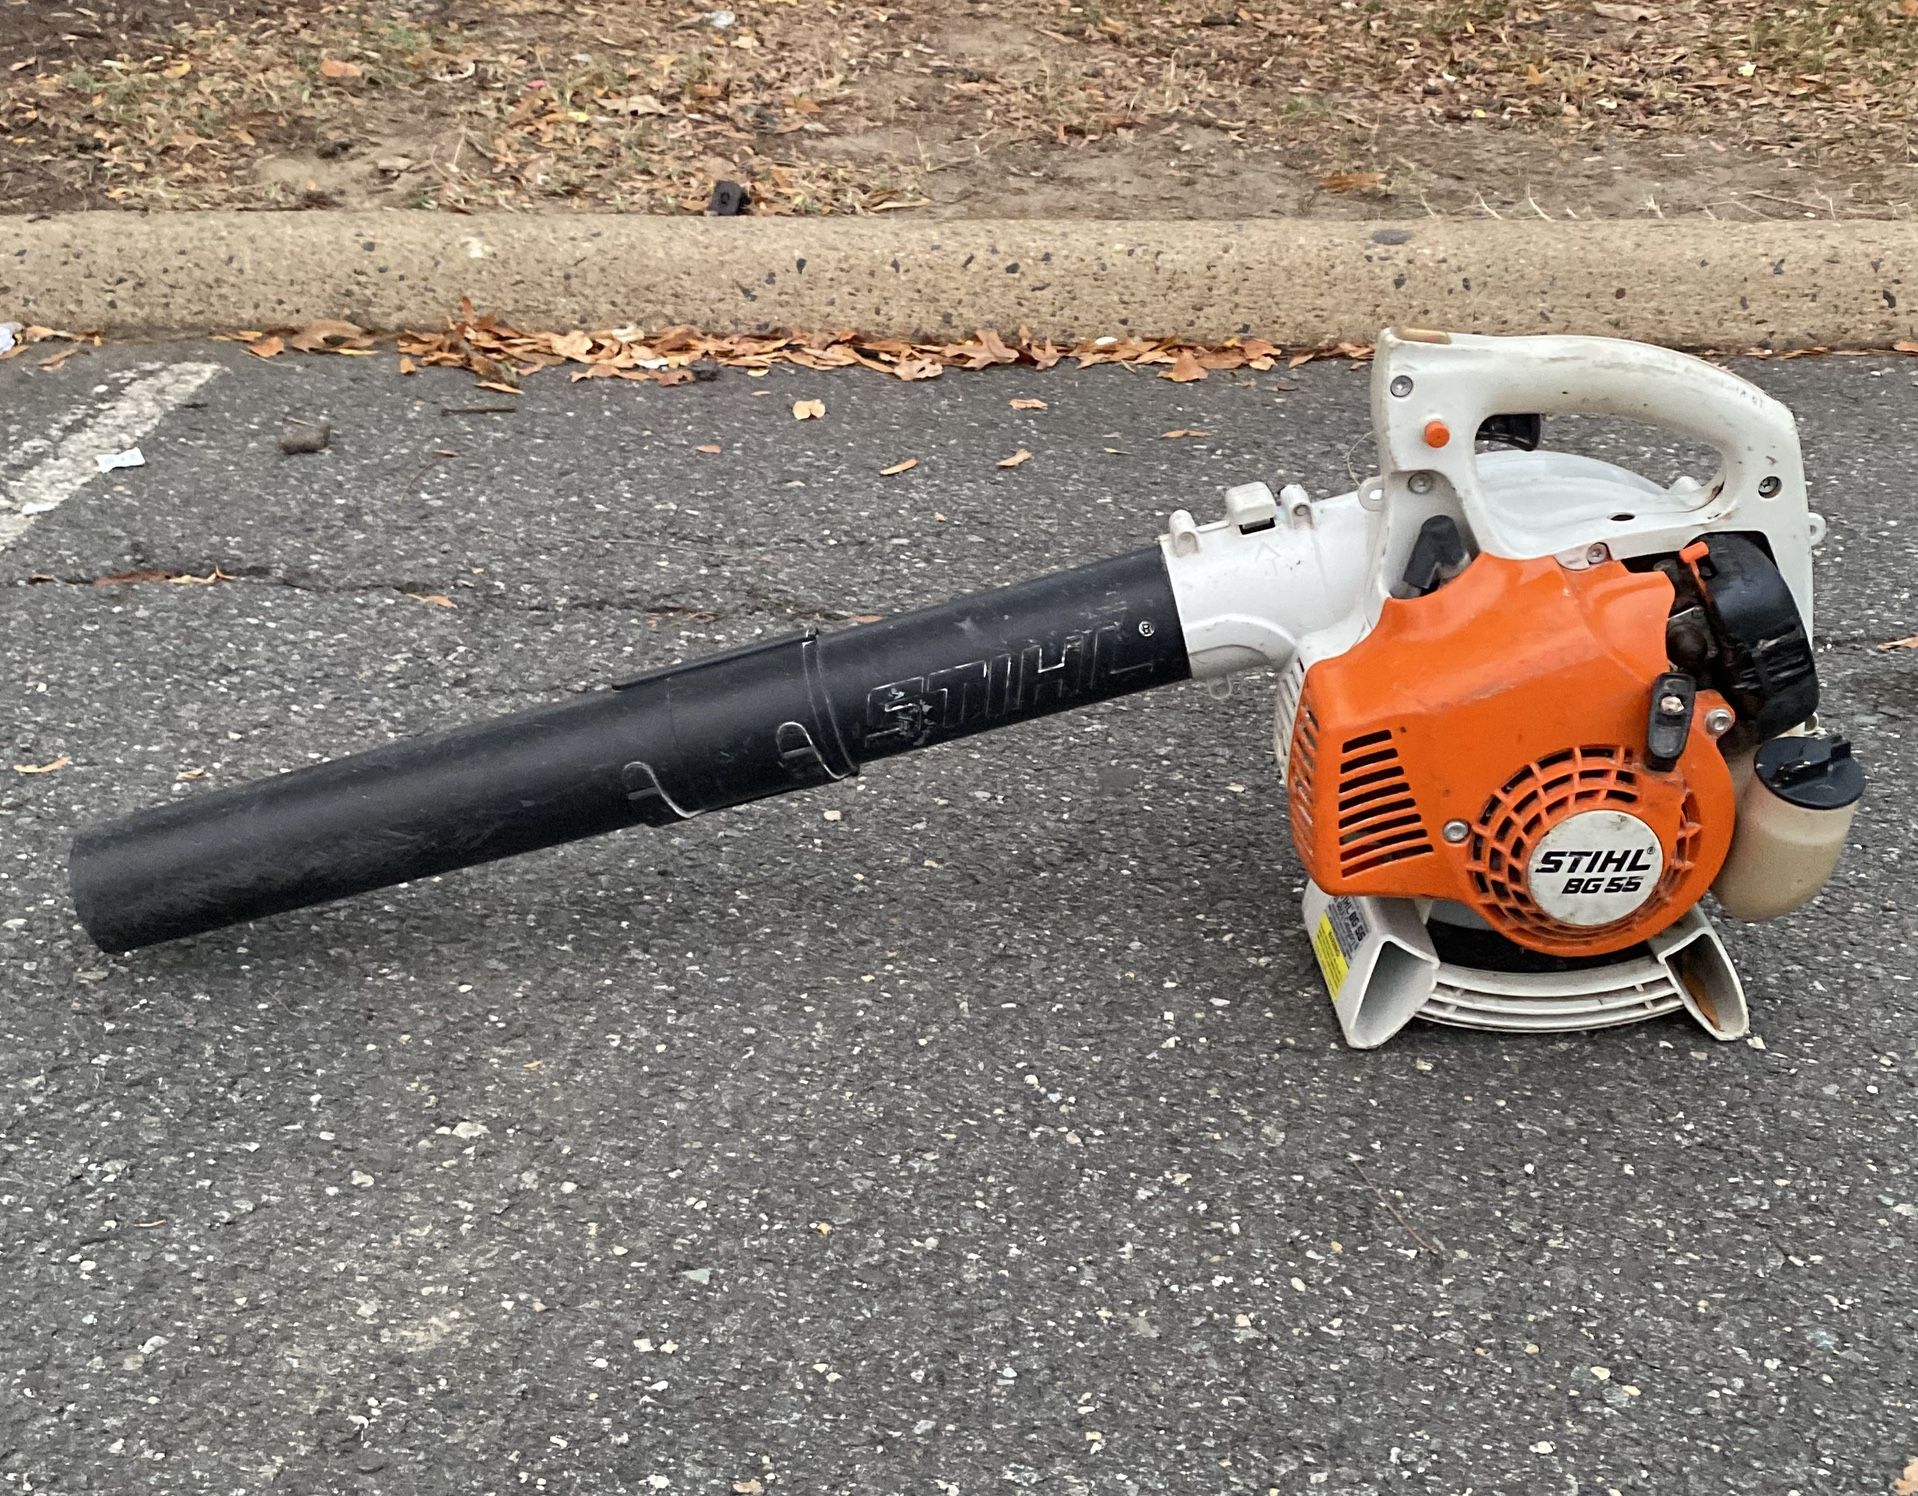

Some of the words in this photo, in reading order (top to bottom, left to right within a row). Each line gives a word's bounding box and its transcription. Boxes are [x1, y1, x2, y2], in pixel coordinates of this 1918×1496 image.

[1562, 877, 1604, 894] BG
[1604, 876, 1644, 893] 55
[1348, 911, 1360, 927] BG
